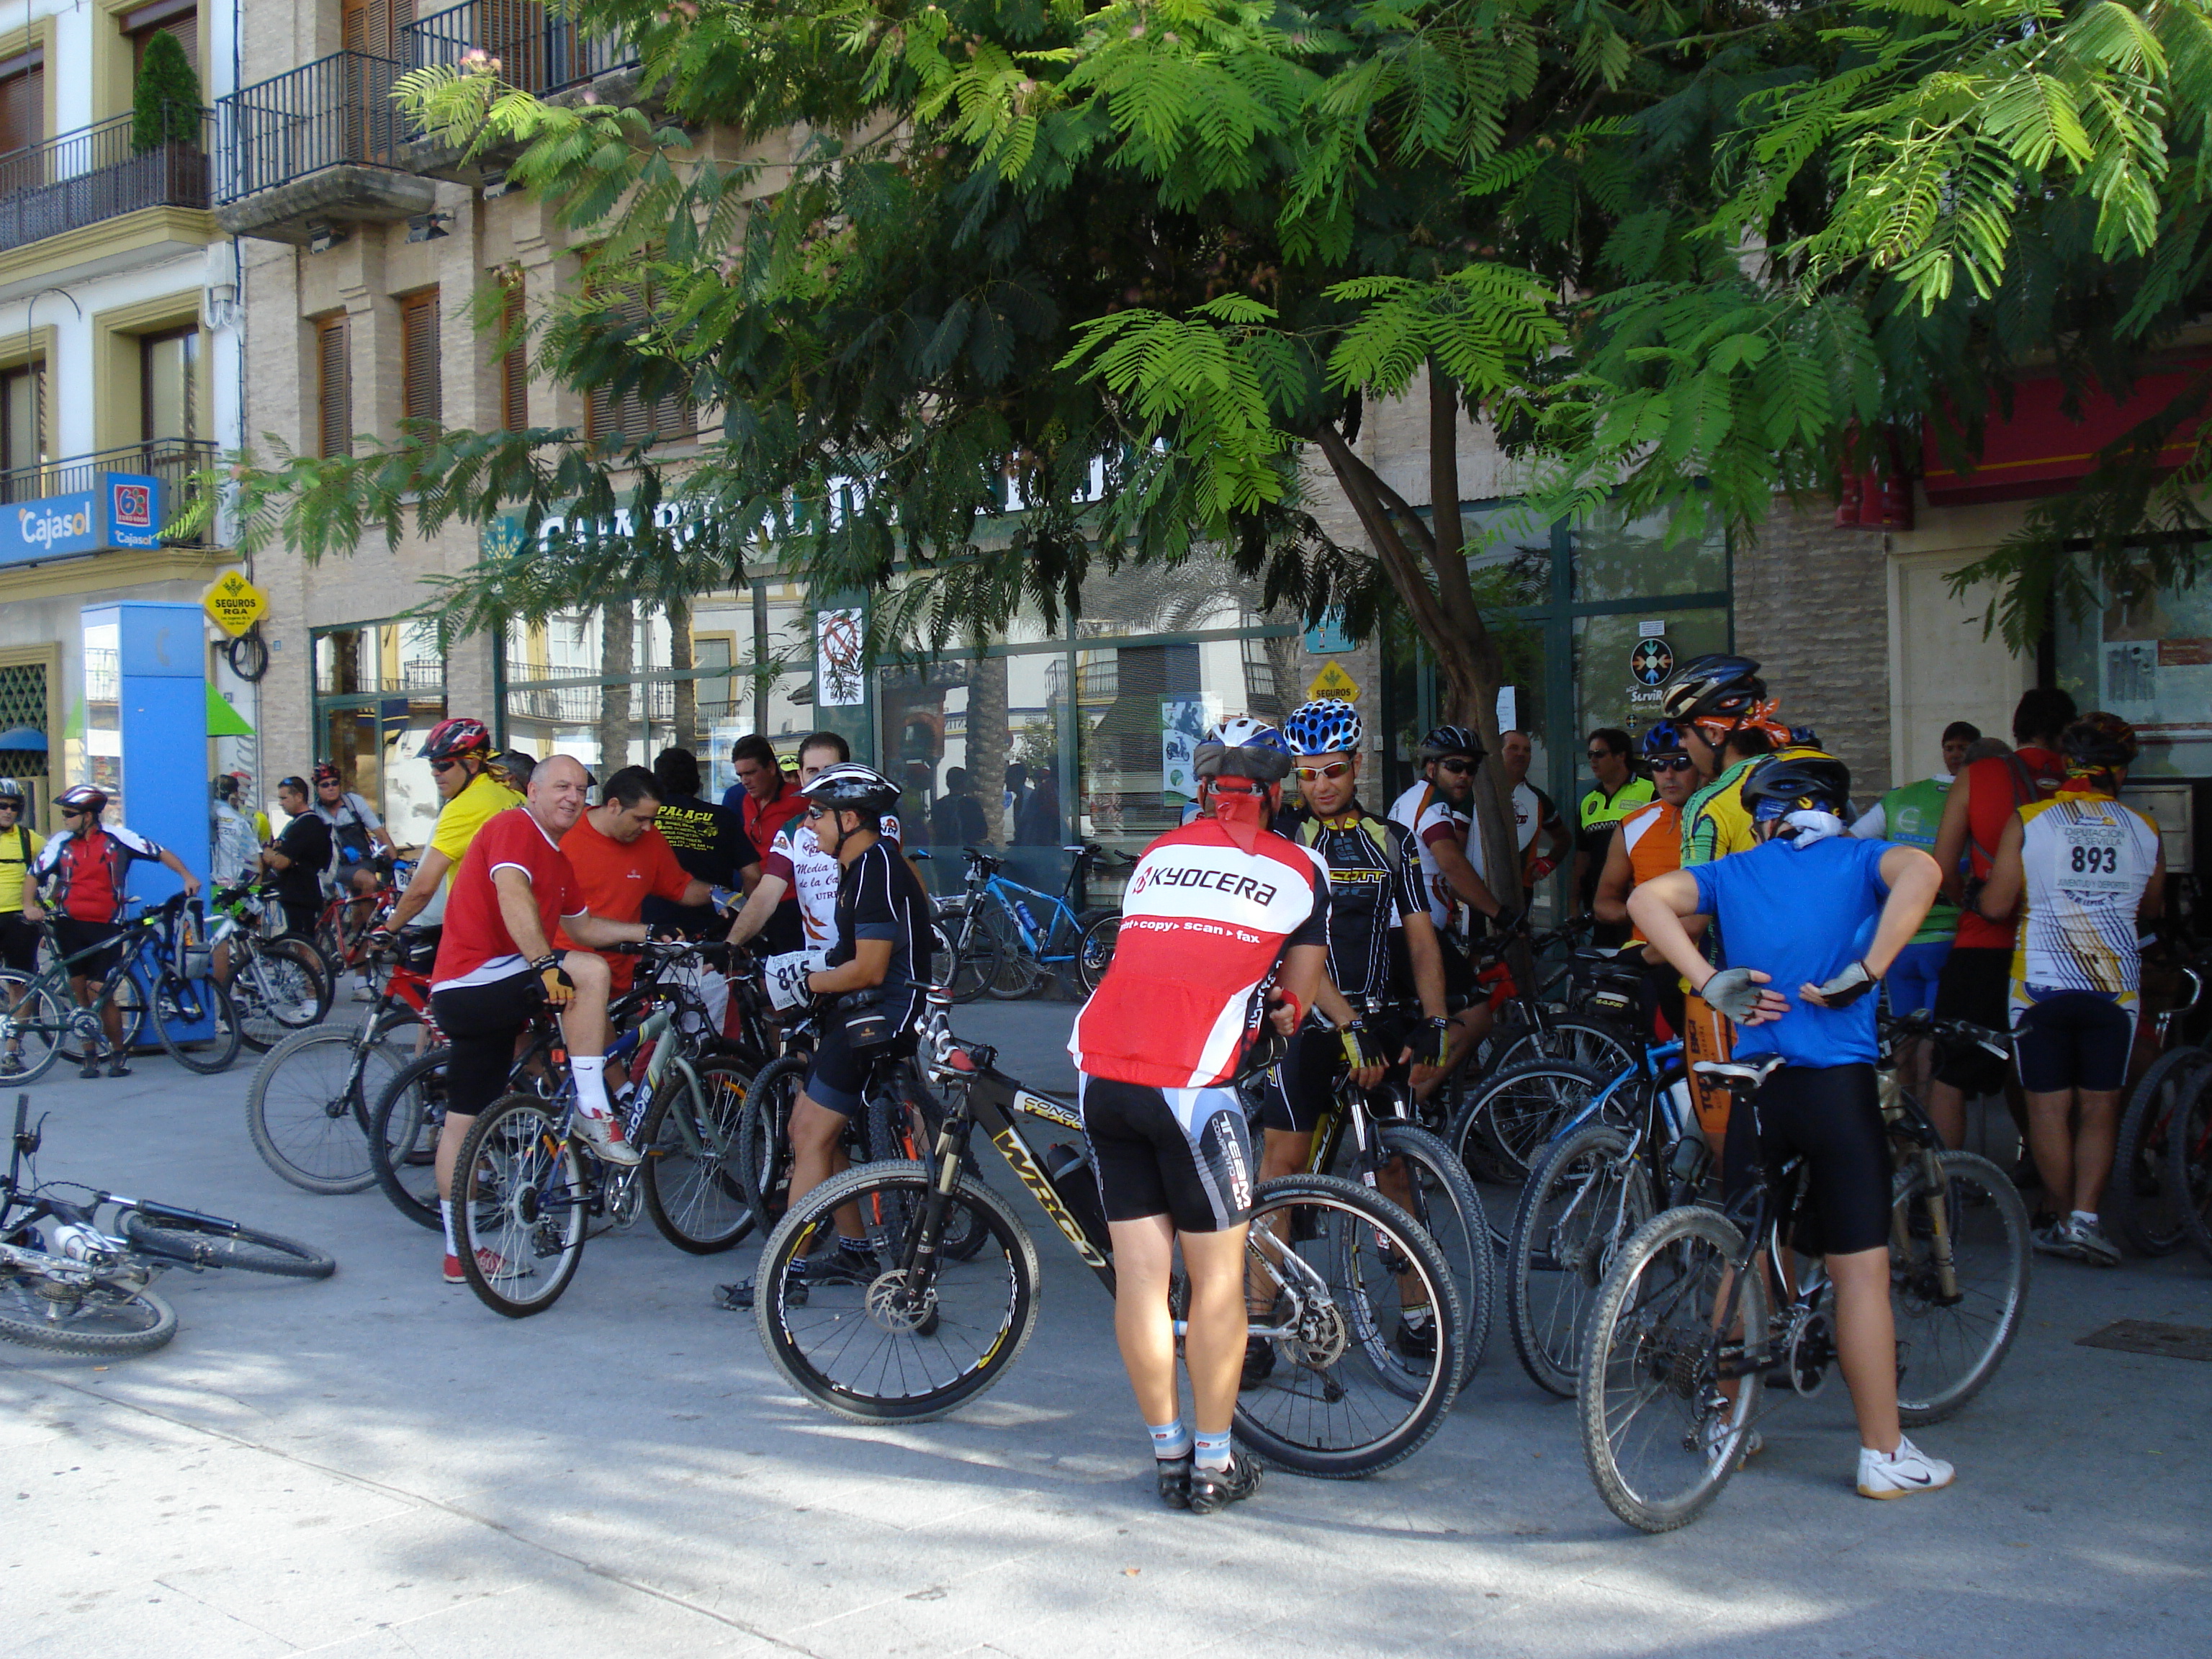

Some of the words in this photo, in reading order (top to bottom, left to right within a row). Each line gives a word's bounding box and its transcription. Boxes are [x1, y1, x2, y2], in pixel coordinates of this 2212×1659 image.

[21, 501, 91, 550] Cajasol
[116, 531, 153, 547] Cajasol
[215, 598, 256, 608] SEGUROS
[1316, 688, 1352, 698] SEGUROS
[2068, 836, 2082, 845] DE
[2085, 837, 2122, 846] SEVILLA
[2071, 845, 2117, 874] 893
[796, 862, 830, 875] Media
[1330, 871, 1385, 881] COTT
[799, 878, 808, 889] de
[810, 877, 821, 886] la
[825, 873, 839, 886] Ca
[1139, 920, 1174, 932] copy
[1183, 921, 1223, 936] scan
[1236, 929, 1261, 944] fax
[1220, 1111, 1252, 1210] TEAM
[802, 1184, 858, 1223] HUTCHINSON
